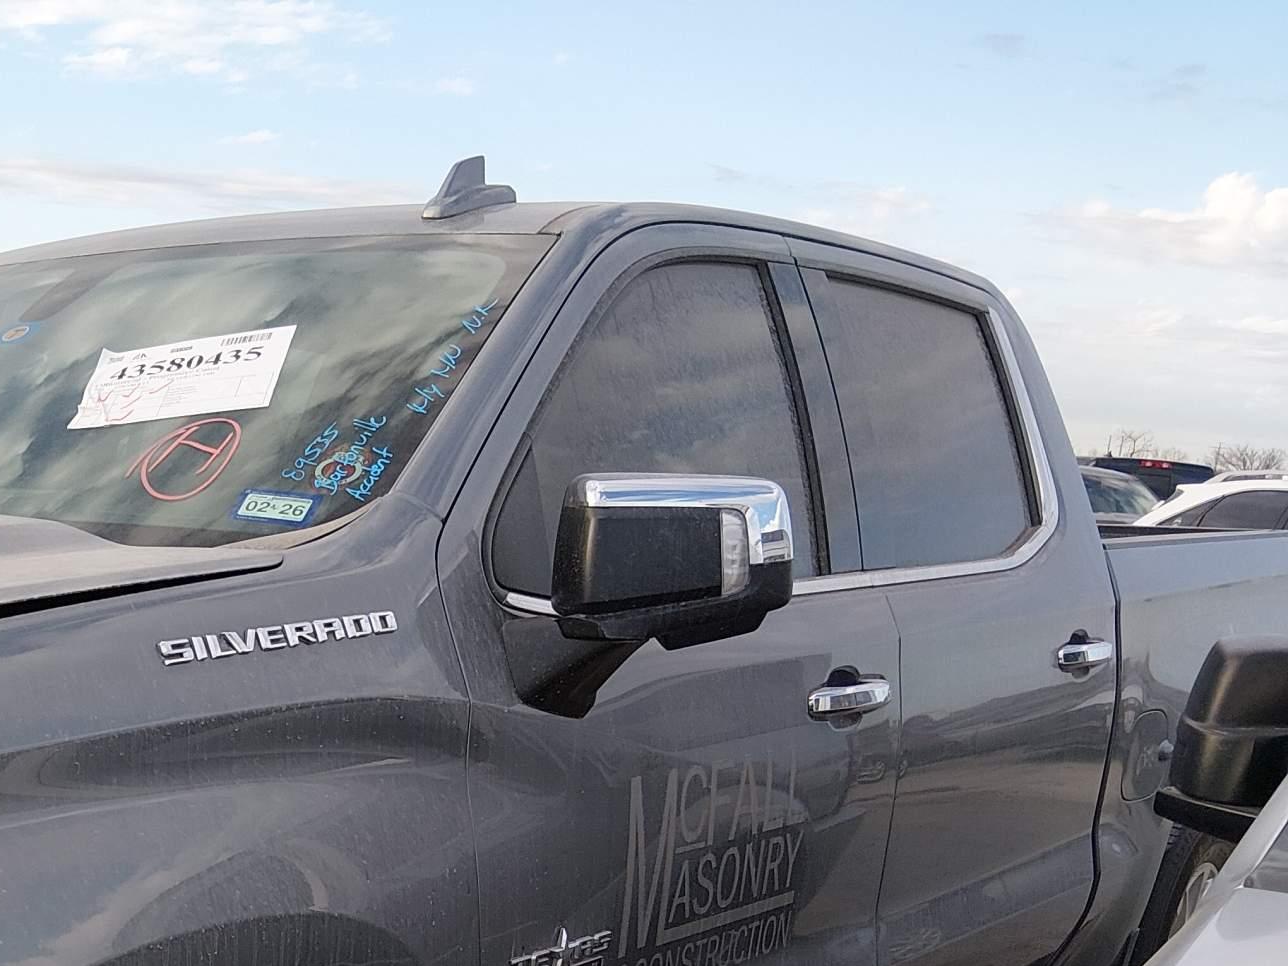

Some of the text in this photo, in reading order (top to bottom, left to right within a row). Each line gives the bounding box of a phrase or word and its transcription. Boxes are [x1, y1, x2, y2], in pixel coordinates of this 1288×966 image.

[110, 345, 265, 380] 43580435
[245, 500, 307, 517] 02 26
[158, 610, 399, 667] SILVERADO
